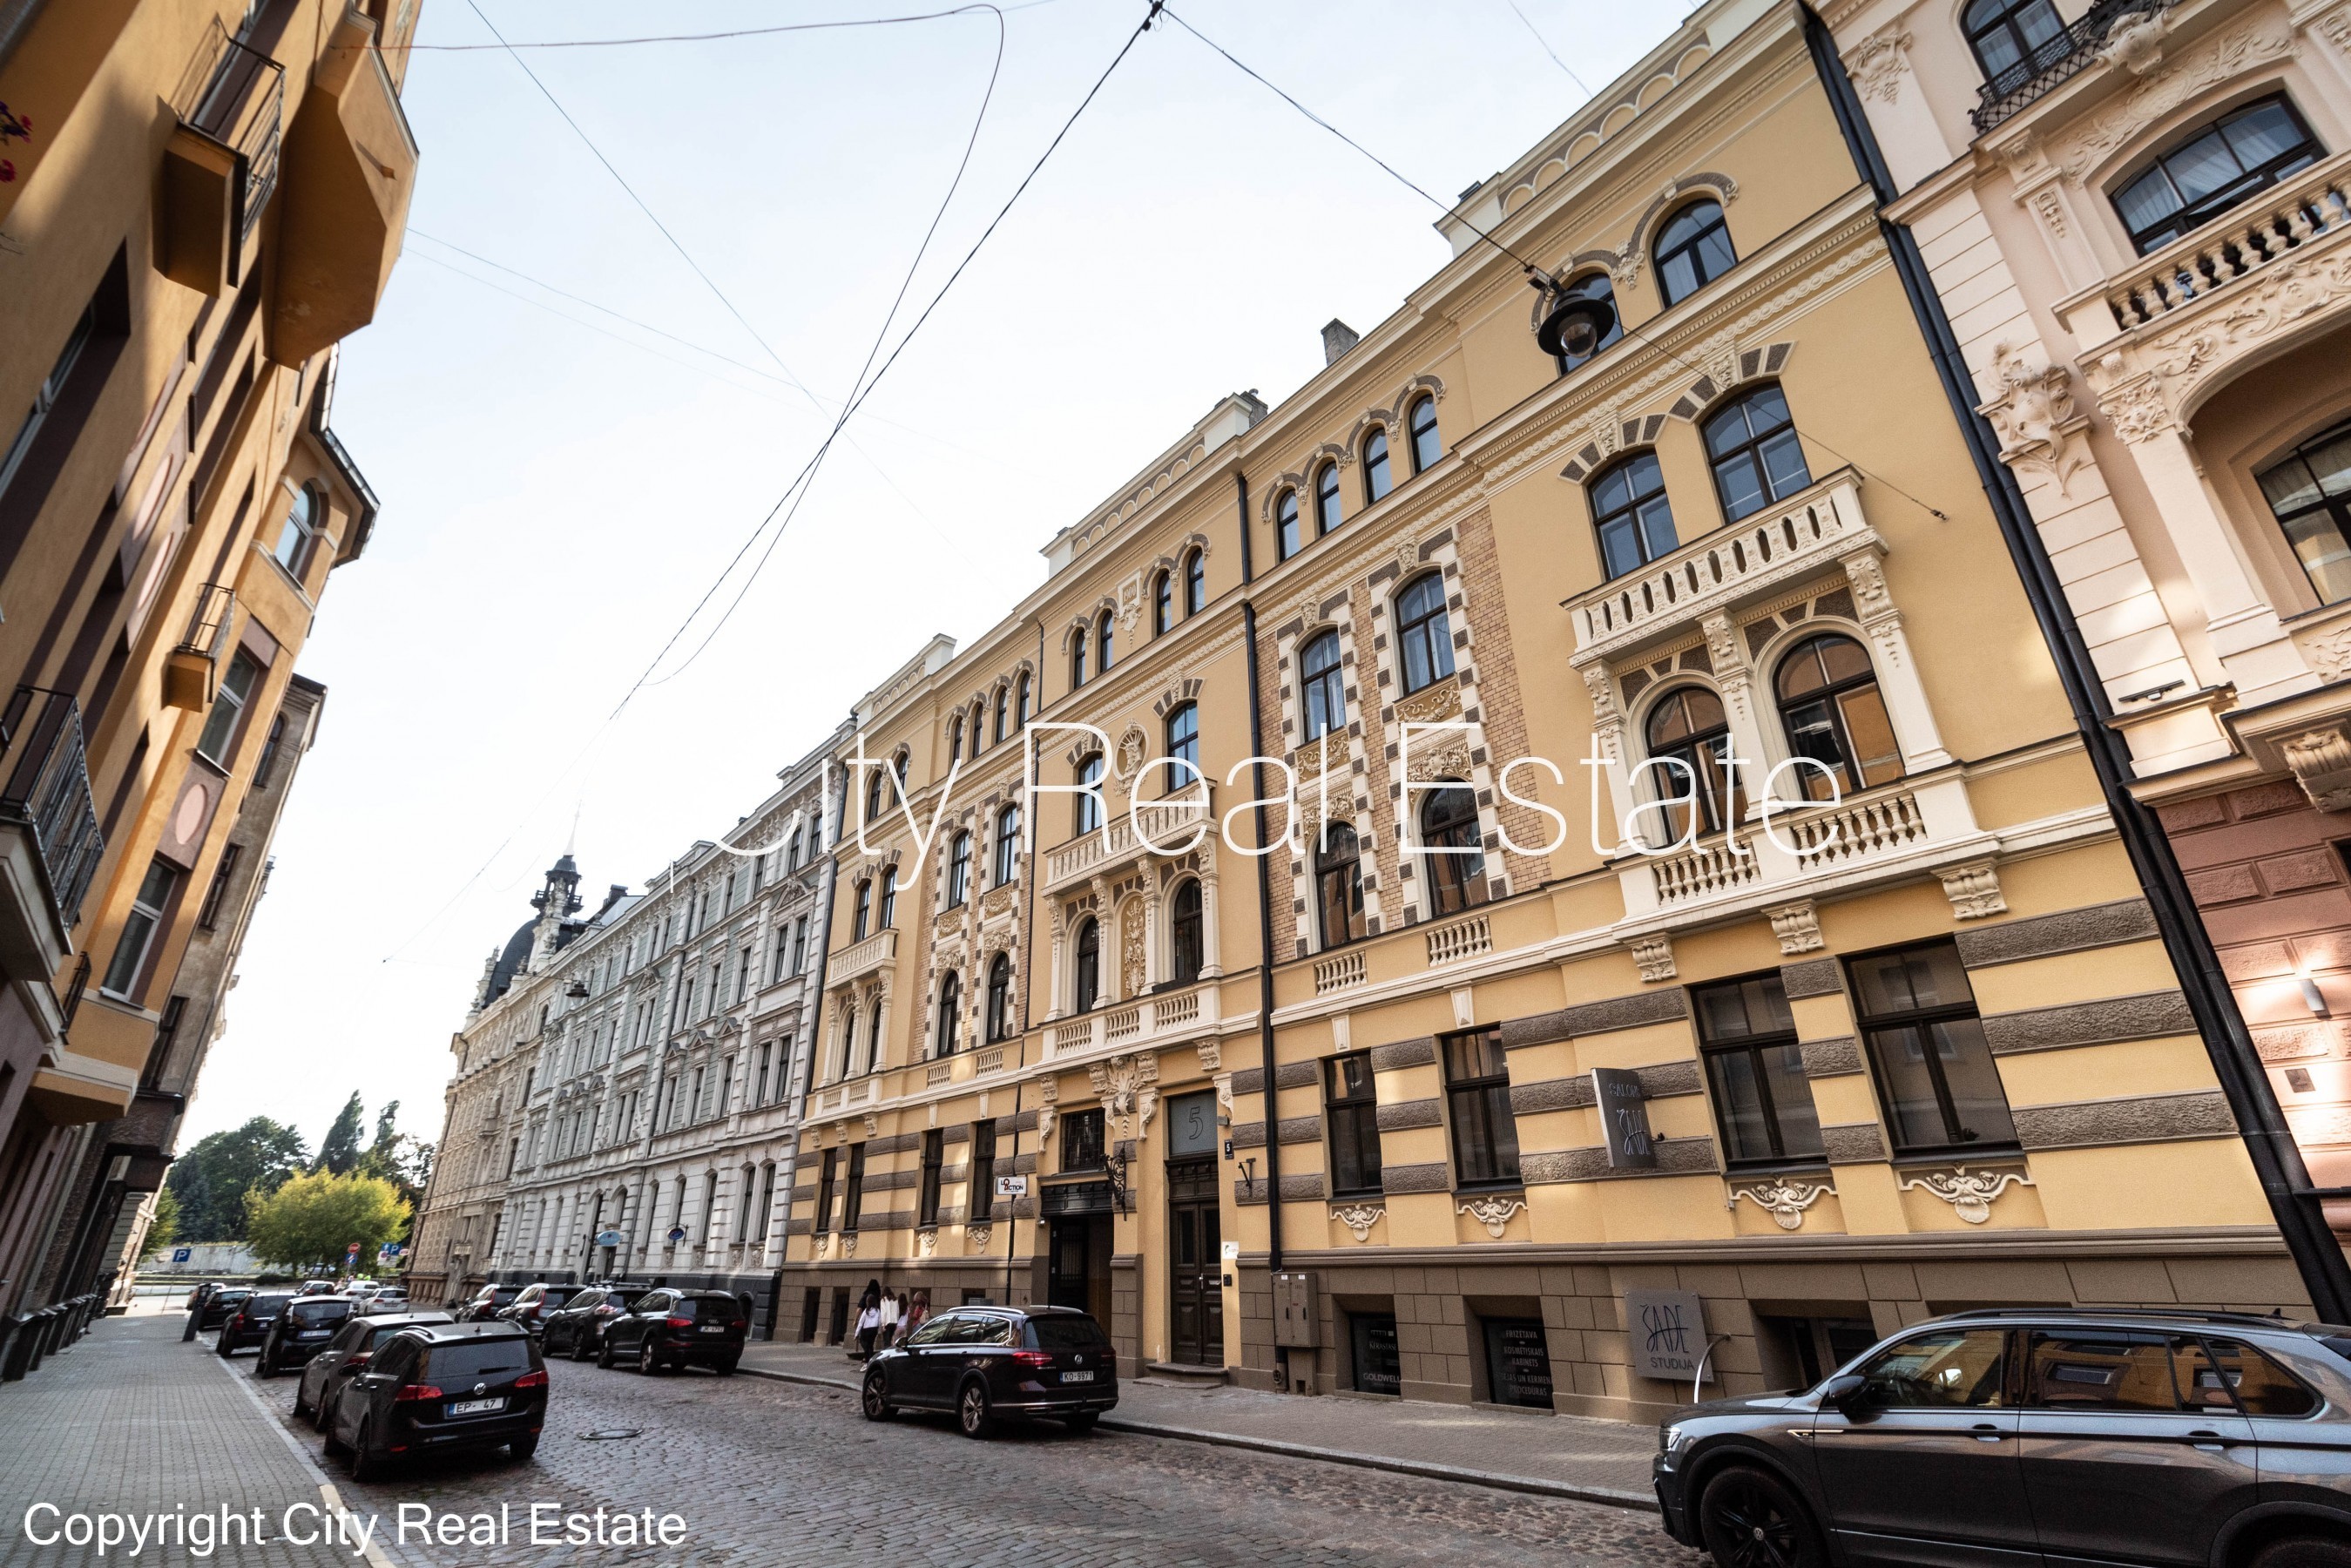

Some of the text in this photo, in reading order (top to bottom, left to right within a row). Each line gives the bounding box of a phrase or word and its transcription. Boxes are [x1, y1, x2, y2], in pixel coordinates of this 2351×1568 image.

[1189, 1105, 1204, 1140] 5
[1226, 1143, 1231, 1152] 5
[389, 1245, 399, 1254] P
[175, 1250, 187, 1261] P
[1650, 1356, 1695, 1371] STUDIJA
